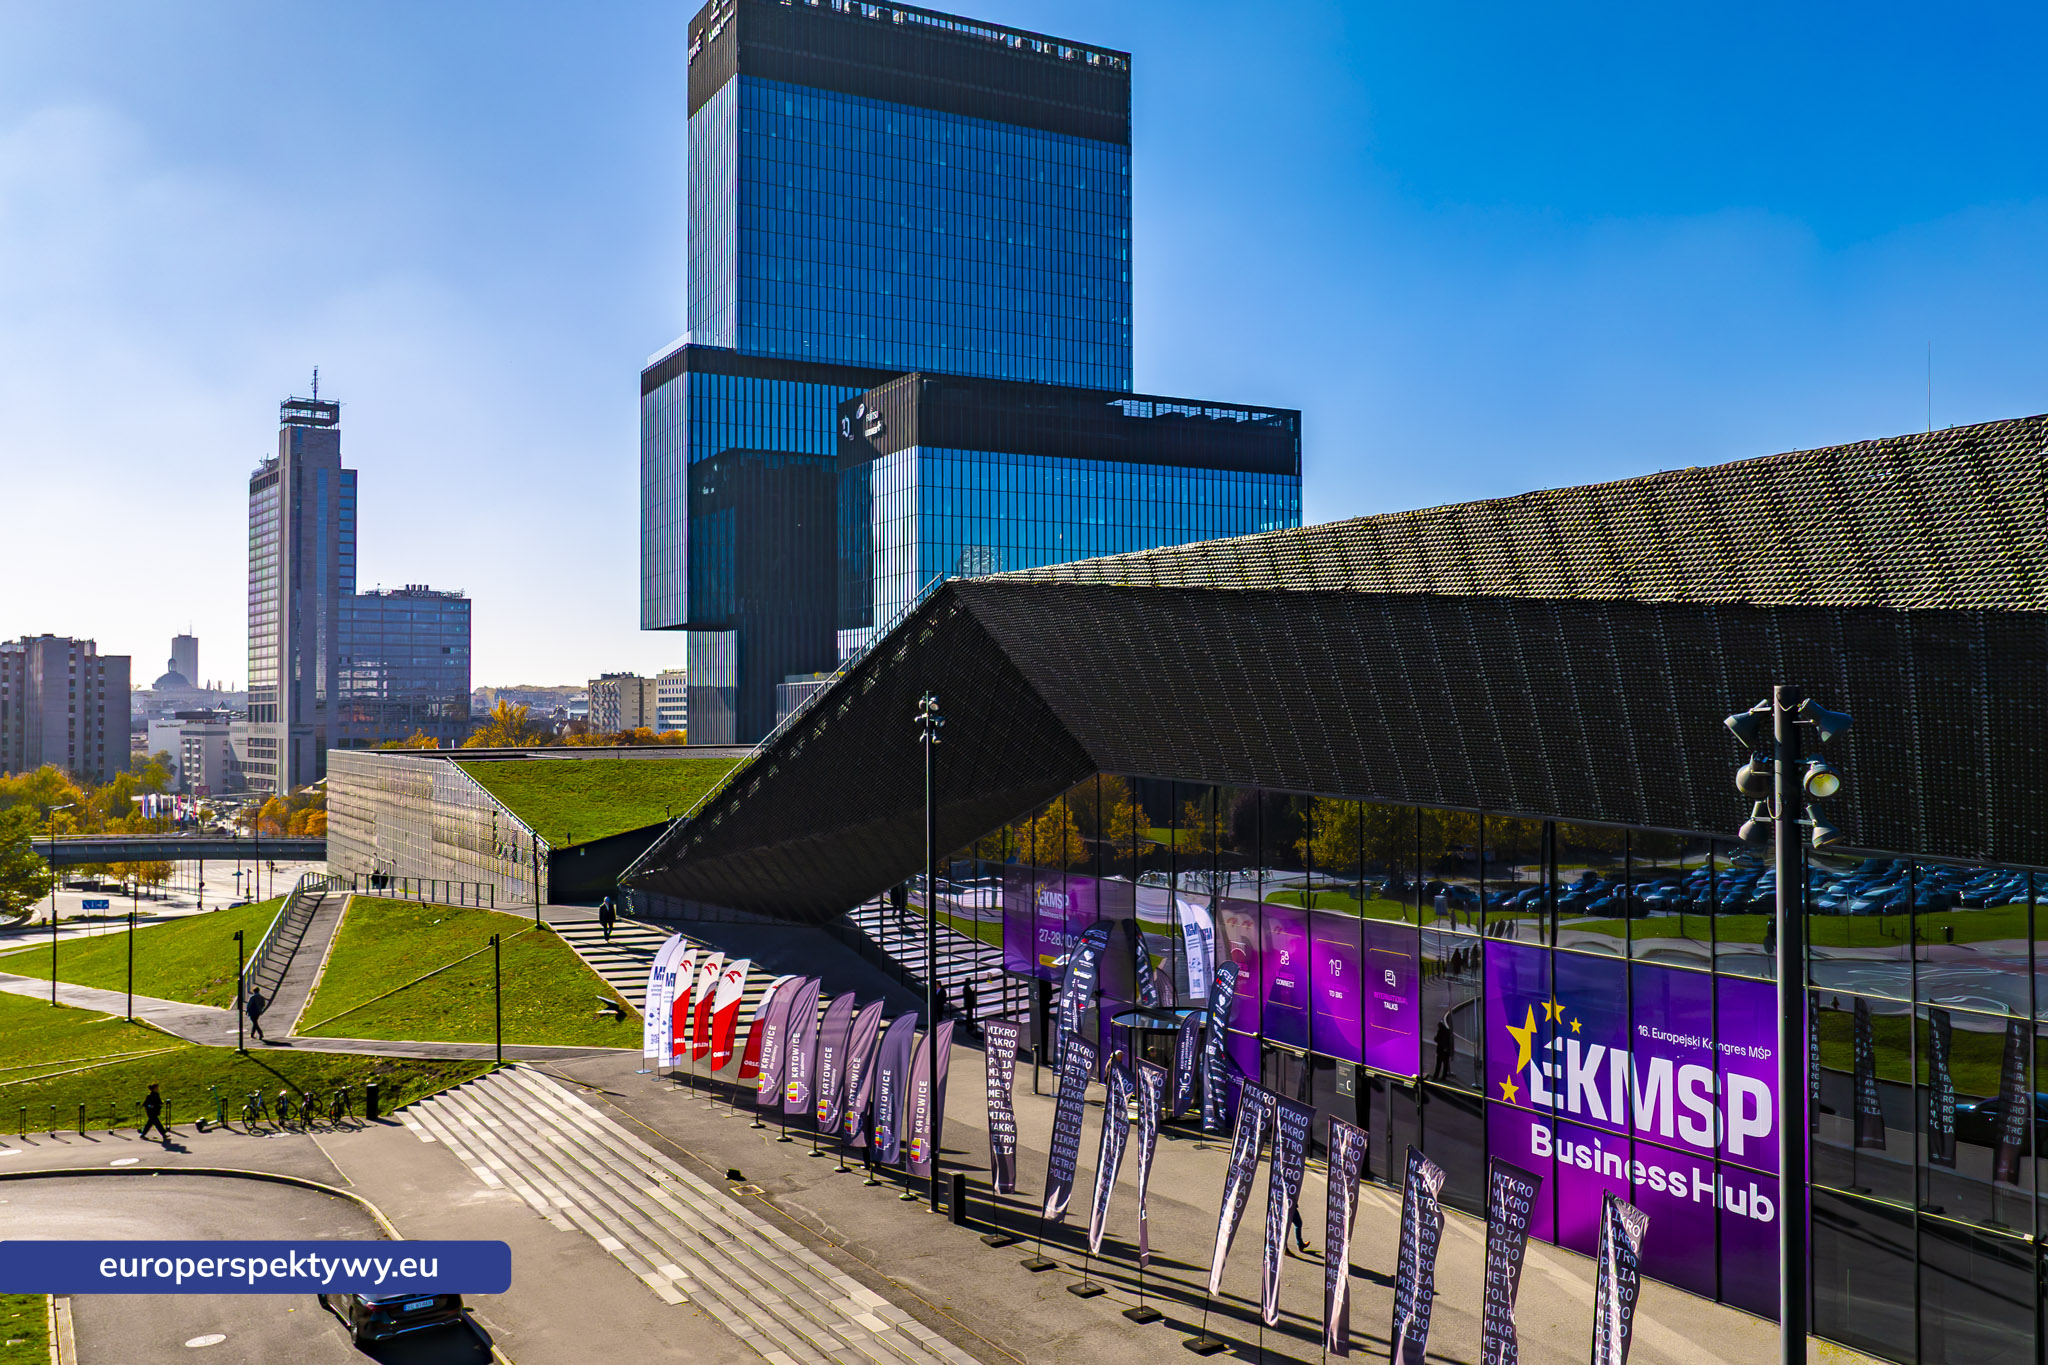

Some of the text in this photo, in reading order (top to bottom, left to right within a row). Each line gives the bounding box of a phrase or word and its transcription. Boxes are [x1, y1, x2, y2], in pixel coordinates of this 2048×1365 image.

[1383, 1001, 1399, 1011] TALKS
[988, 1026, 1017, 1038] MIKRO
[1637, 1024, 1772, 1061] 16. Europejski Kongres MŚP
[761, 1024, 777, 1069] KATOWICE
[791, 1032, 801, 1078] KATOWICE
[1068, 1041, 1095, 1059] MIKRO
[822, 1046, 833, 1096] KATOWICE
[988, 1057, 1012, 1069] PIA
[1064, 1063, 1087, 1080] METRO
[1066, 1053, 1092, 1070] MAKRO
[848, 1057, 861, 1107] KATOWICE
[988, 1068, 1012, 1080] MIRO
[988, 1079, 1011, 1091] MAO
[879, 1069, 891, 1121] KATOWICE
[988, 1100, 1012, 1110] POL
[1244, 1083, 1276, 1105] MIKRO
[1530, 1036, 1773, 1156] EKMSP
[914, 1080, 928, 1133] KATOWICE
[1242, 1096, 1271, 1118] MAKRO
[1277, 1105, 1309, 1127] MIKRO
[990, 1122, 1015, 1132] AKRO
[1241, 1110, 1266, 1131] ETO
[1279, 1121, 1305, 1140] AKRO
[992, 1134, 1016, 1143] ETRO
[1332, 1122, 1365, 1147] MIRO
[1274, 1146, 1302, 1168] PLIA
[1332, 1137, 1361, 1161] MRO
[1051, 1156, 1076, 1171] METRO
[1230, 1164, 1252, 1182] ETRO
[1273, 1160, 1301, 1181] MKRO
[1331, 1152, 1357, 1175] MERO
[1531, 1122, 1775, 1223] Business Hub
[1271, 1174, 1297, 1195] MARO
[1330, 1166, 1356, 1188] POIA
[1493, 1171, 1534, 1198] MIKRO
[1404, 1217, 1436, 1243] MIKRO
[1489, 1220, 1522, 1246] POIA
[1403, 1231, 1434, 1257] MAKRO
[1399, 1260, 1433, 1287] POLIA
[1397, 1274, 1432, 1300] MIKRO
[1486, 1286, 1511, 1304] POL
[1396, 1289, 1431, 1315] MAKRO
[1487, 1303, 1512, 1321] IKR
[1394, 1303, 1428, 1330] METRO
[1393, 1318, 1426, 1346] POLIA
[1486, 1319, 1513, 1338] MAKR
